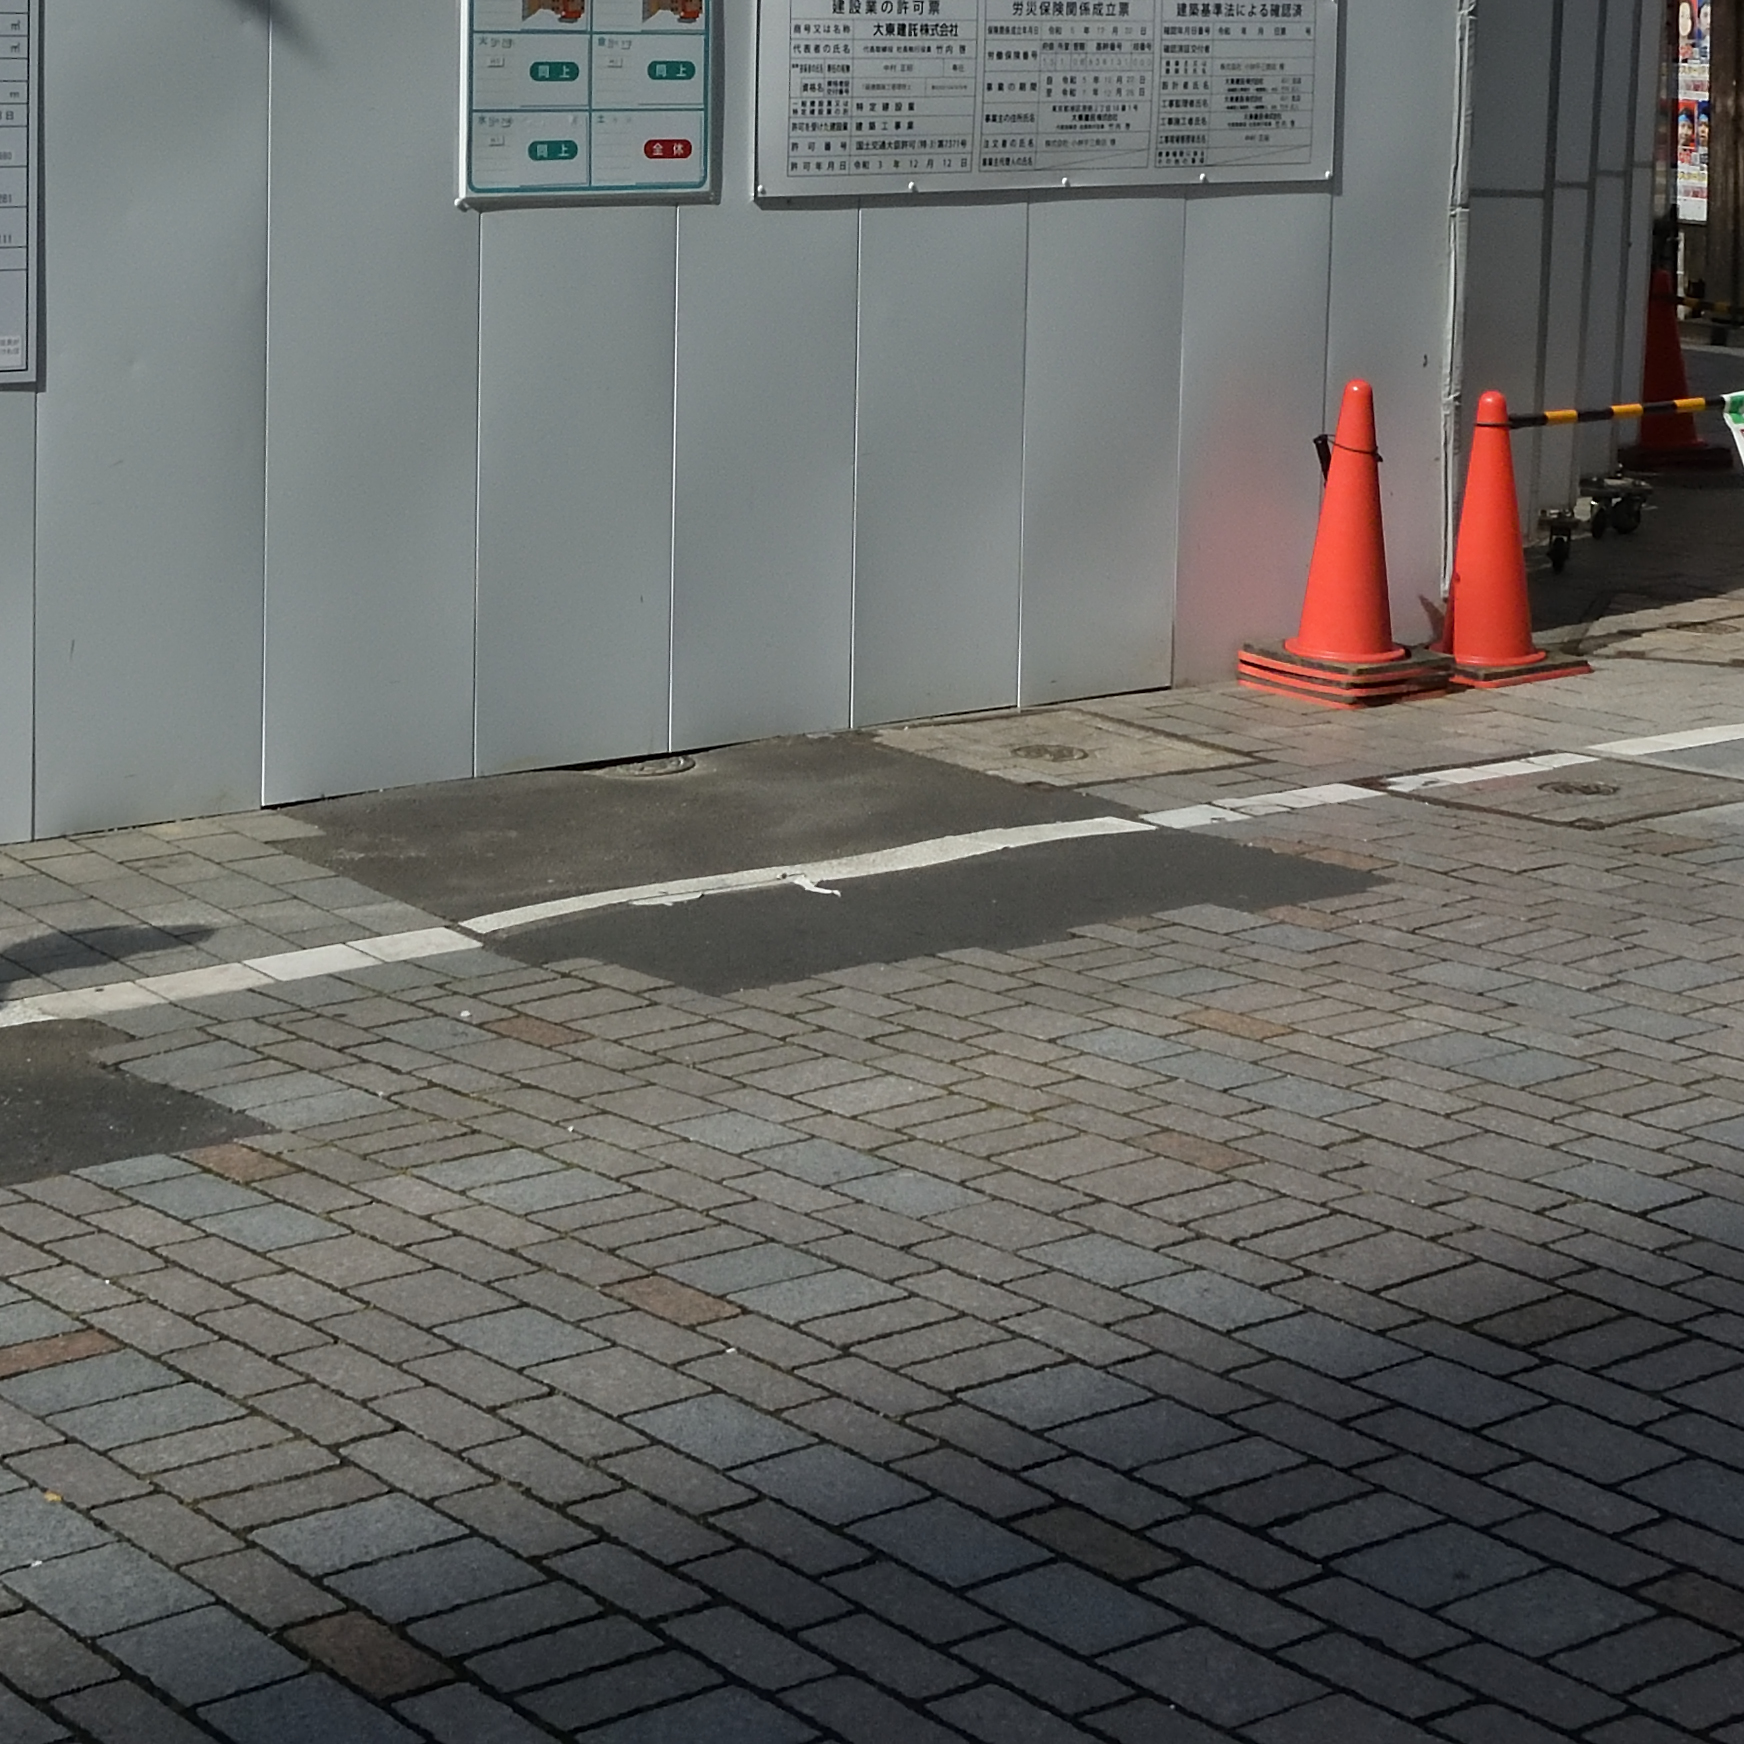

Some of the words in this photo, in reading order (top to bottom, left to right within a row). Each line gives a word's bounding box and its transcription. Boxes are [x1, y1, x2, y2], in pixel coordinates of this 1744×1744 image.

[1012, 0, 1131, 17] 労災保険関係成立票
[1176, 2, 1303, 18] 建築基準法による確認済
[872, 22, 959, 38] 大東建託株式会社
